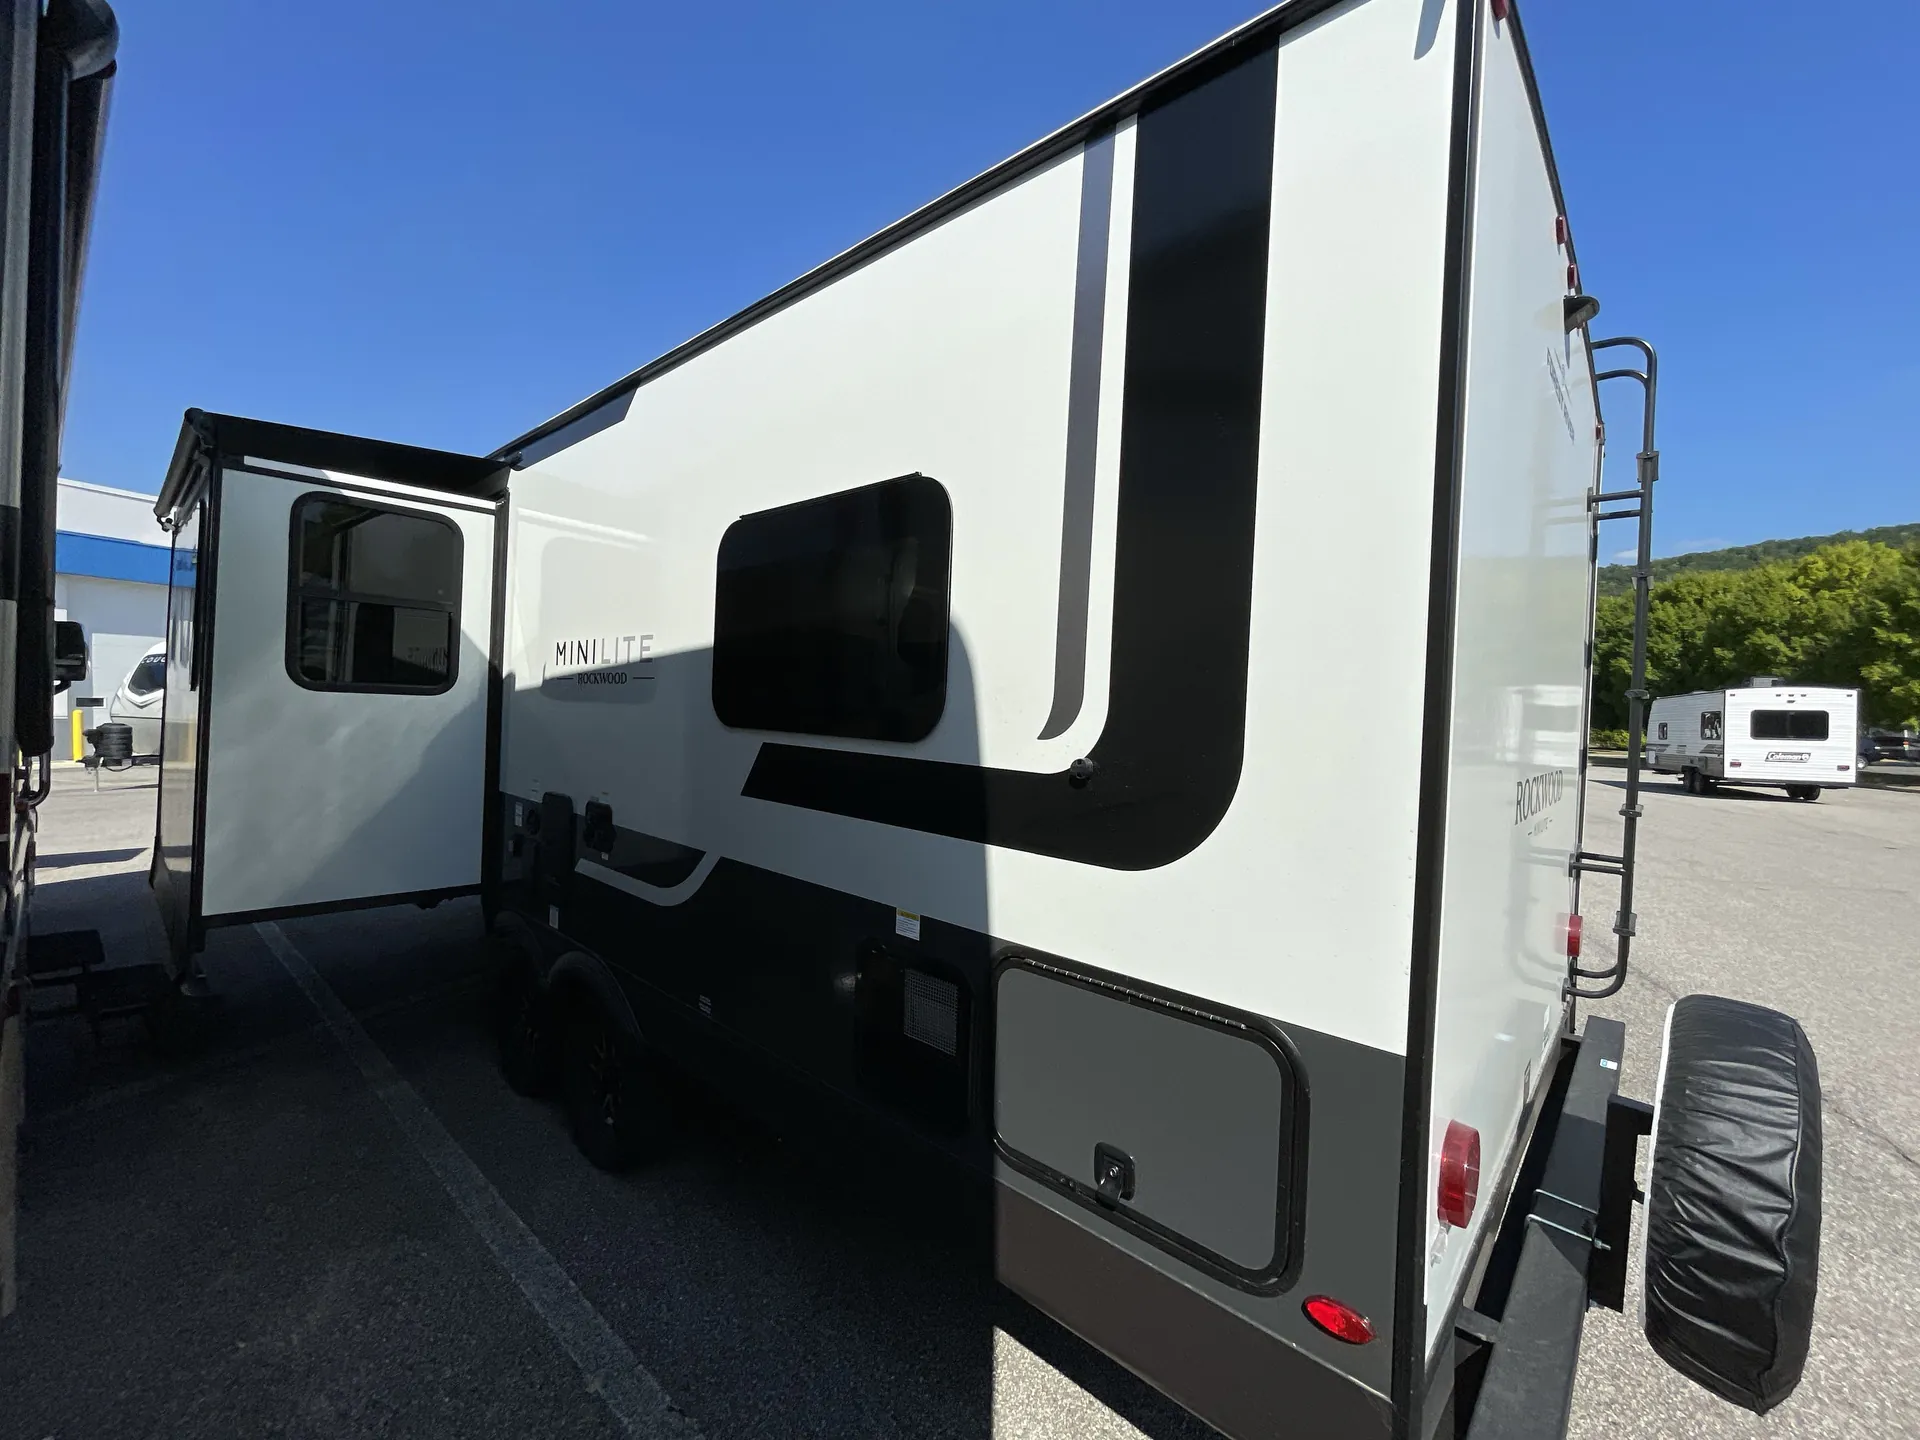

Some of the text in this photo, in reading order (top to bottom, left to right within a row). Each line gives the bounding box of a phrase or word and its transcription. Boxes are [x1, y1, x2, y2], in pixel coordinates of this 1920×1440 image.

[577, 672, 628, 686] ROCKWOOD
[1767, 752, 1802, 761] Coleman
[1514, 769, 1564, 826] ROCKWOOD
